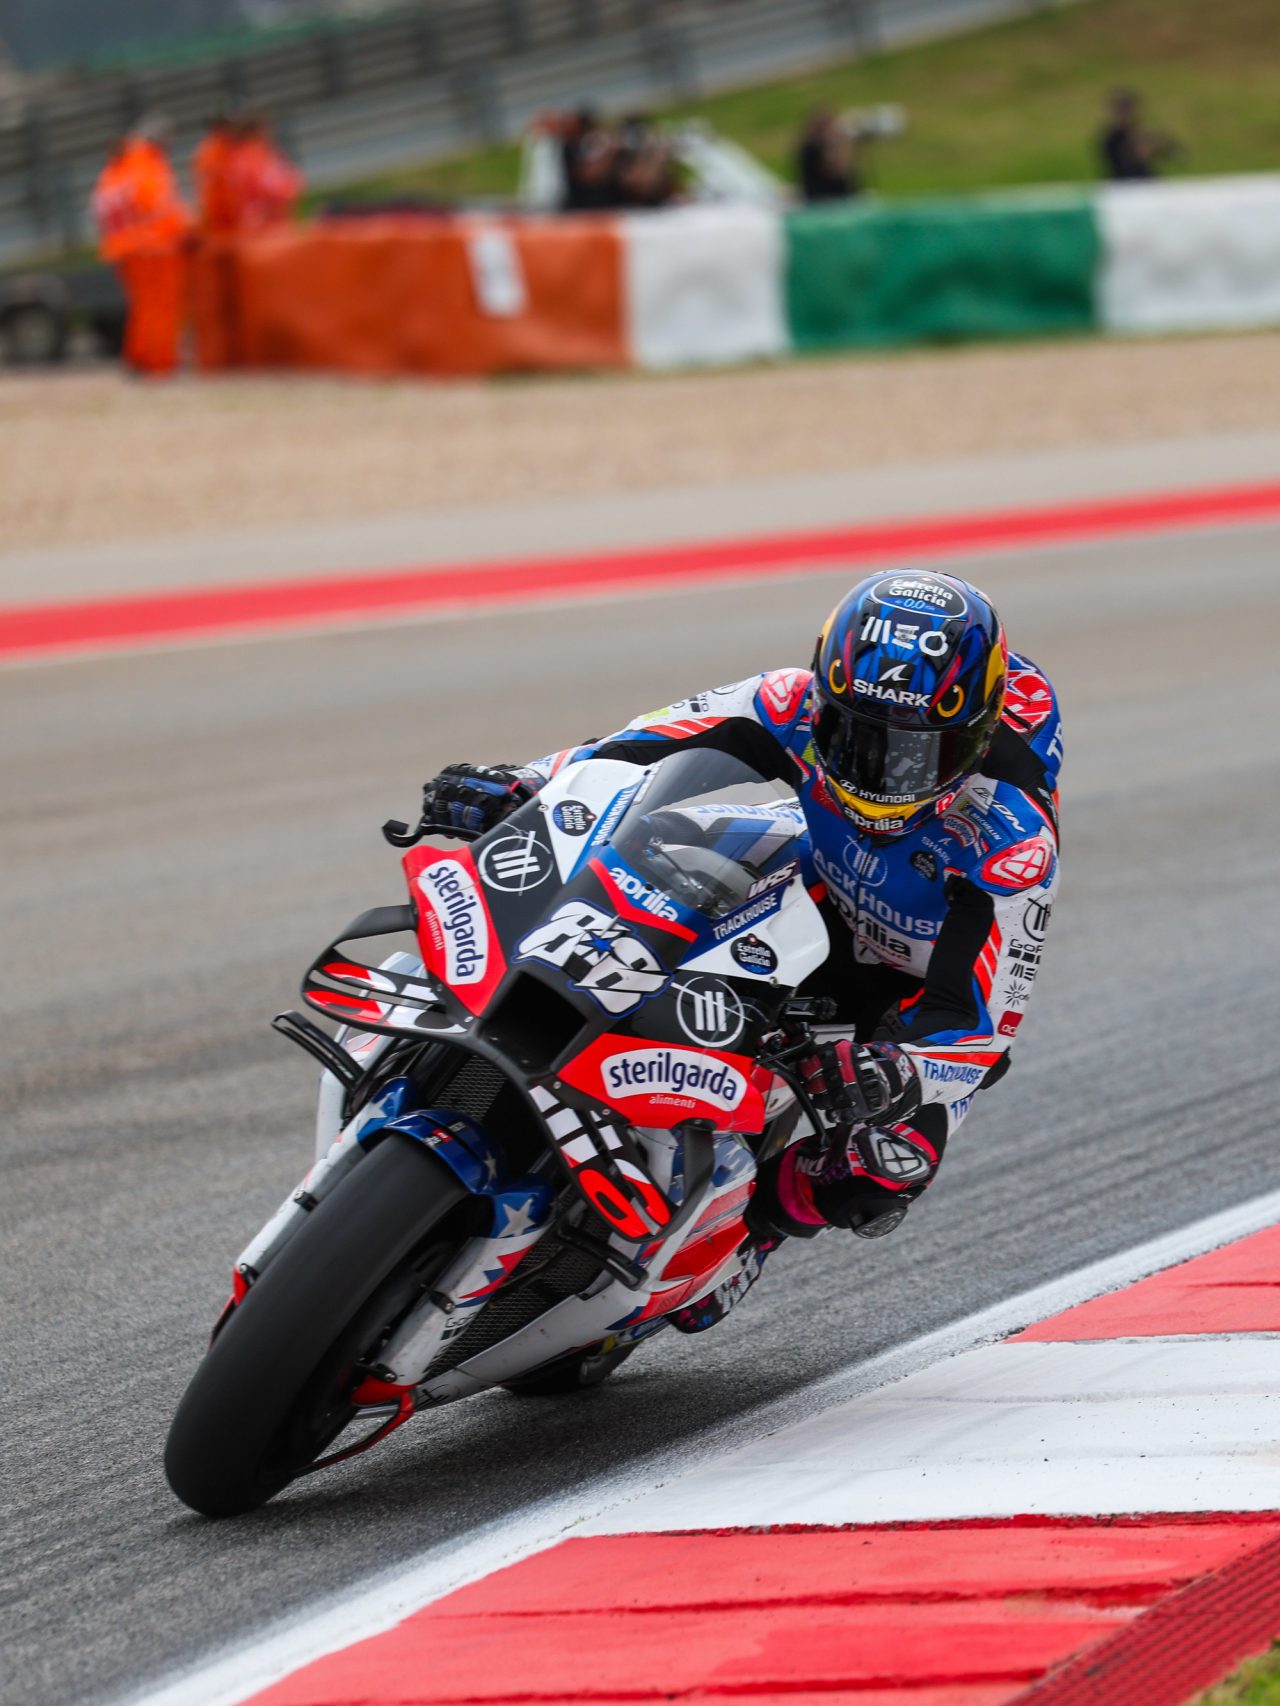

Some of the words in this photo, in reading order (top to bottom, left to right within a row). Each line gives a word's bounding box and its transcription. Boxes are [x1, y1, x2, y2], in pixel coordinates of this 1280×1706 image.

[889, 586, 947, 608] Galicia
[890, 579, 953, 600] Estrella
[860, 616, 949, 657] MEO
[852, 678, 932, 708] SHARK
[859, 789, 916, 803] HYUNDAI
[844, 806, 904, 831] aprilia
[609, 867, 679, 922] aprilia
[748, 861, 797, 898] WRS
[425, 910, 444, 952] alimenti
[428, 866, 484, 978] sterilgarda
[712, 892, 778, 940] TRACKHOUSE
[737, 942, 771, 958] Estrella
[608, 1052, 737, 1101] sterilgarda
[649, 1094, 697, 1109] alimenti
